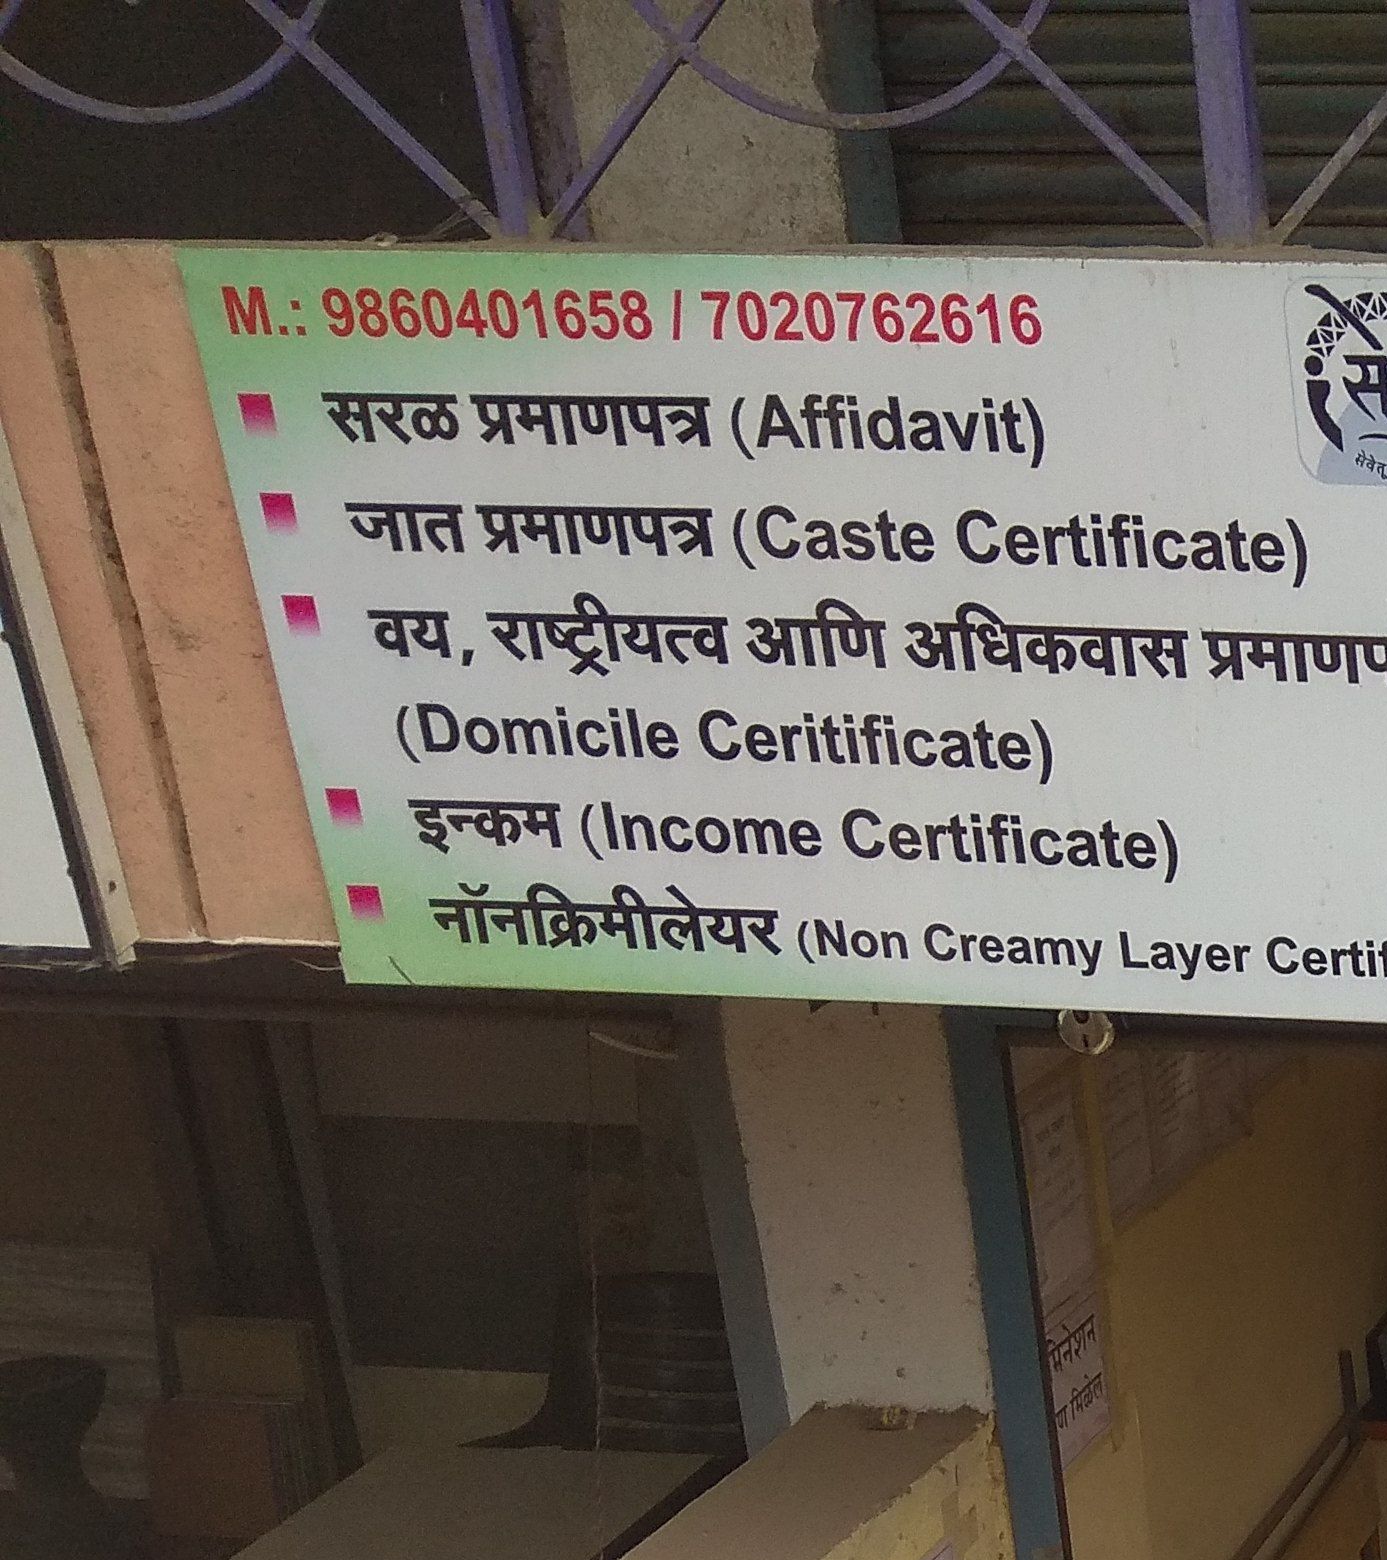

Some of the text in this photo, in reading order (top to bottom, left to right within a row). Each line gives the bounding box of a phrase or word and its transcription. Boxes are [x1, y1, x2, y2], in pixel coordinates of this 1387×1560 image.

[322, 288, 652, 340] 9860401658
[701, 291, 1041, 345] 7020762616
[321, 392, 1044, 468] सरळ प्रमाणपत्र (Affidavit)
[345, 503, 1307, 588] जात प्रमाणपत्र (Caste Certificate)
[367, 610, 473, 666] वय,
[486, 592, 728, 676] राष्ट्रीयत्व
[746, 599, 886, 668] आणि
[905, 602, 1188, 678] अधिकवास
[397, 703, 1052, 784] (Domicile Ceritificate)
[408, 800, 1177, 883] इन्कम (Income Certificate)
[429, 883, 781, 955] नॉनक्रिमीलेयर
[798, 919, 908, 963] (Non
[924, 924, 1102, 976] Creamy
[1120, 932, 1251, 980] Layer
